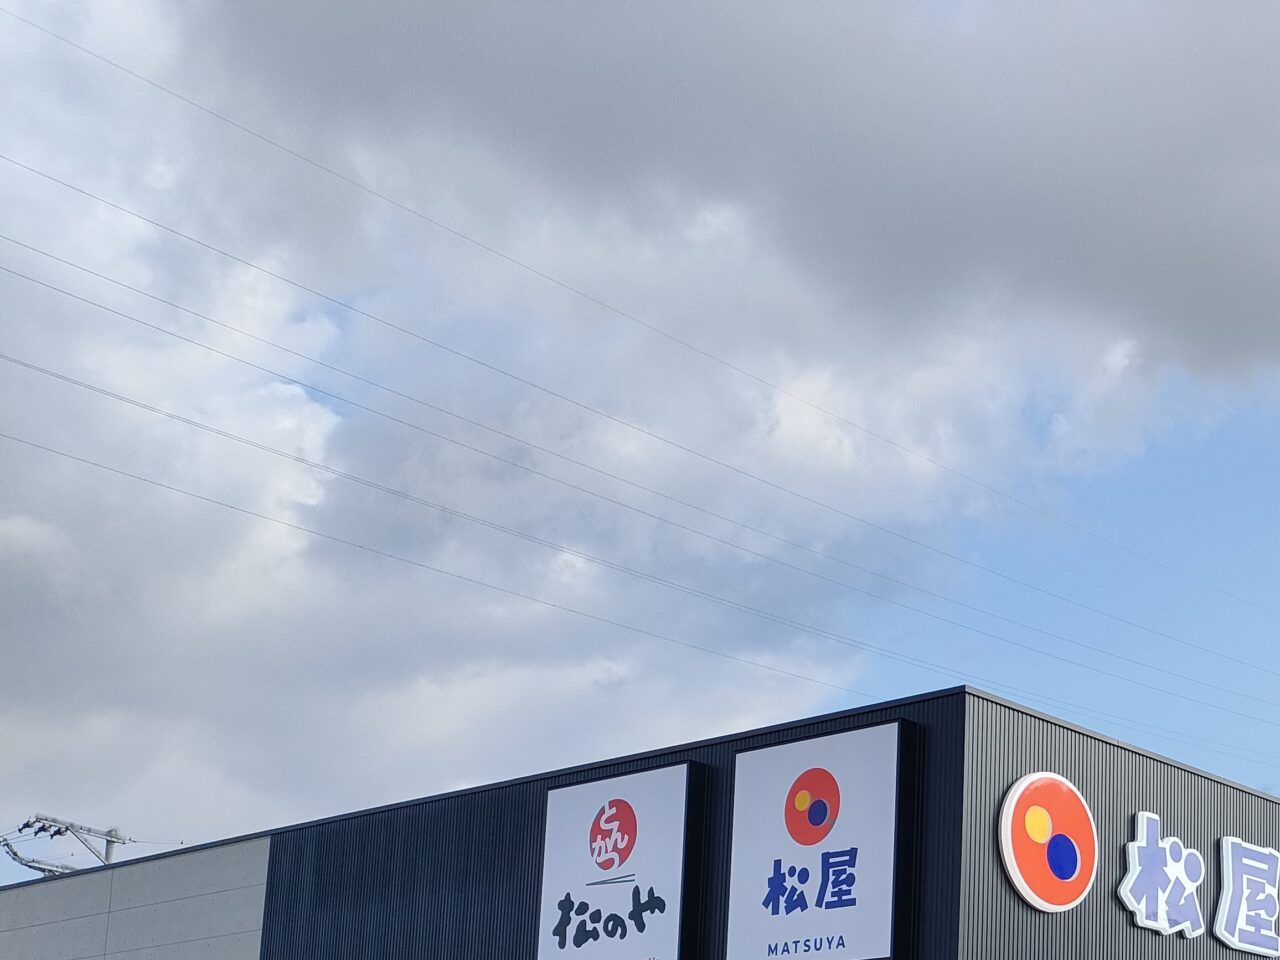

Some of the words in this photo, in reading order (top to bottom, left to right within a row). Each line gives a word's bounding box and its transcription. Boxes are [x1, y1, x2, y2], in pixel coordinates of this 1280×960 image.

[762, 847, 858, 916] 松屋
[552, 885, 666, 949] 松のや
[767, 935, 846, 957] MATSUYA
